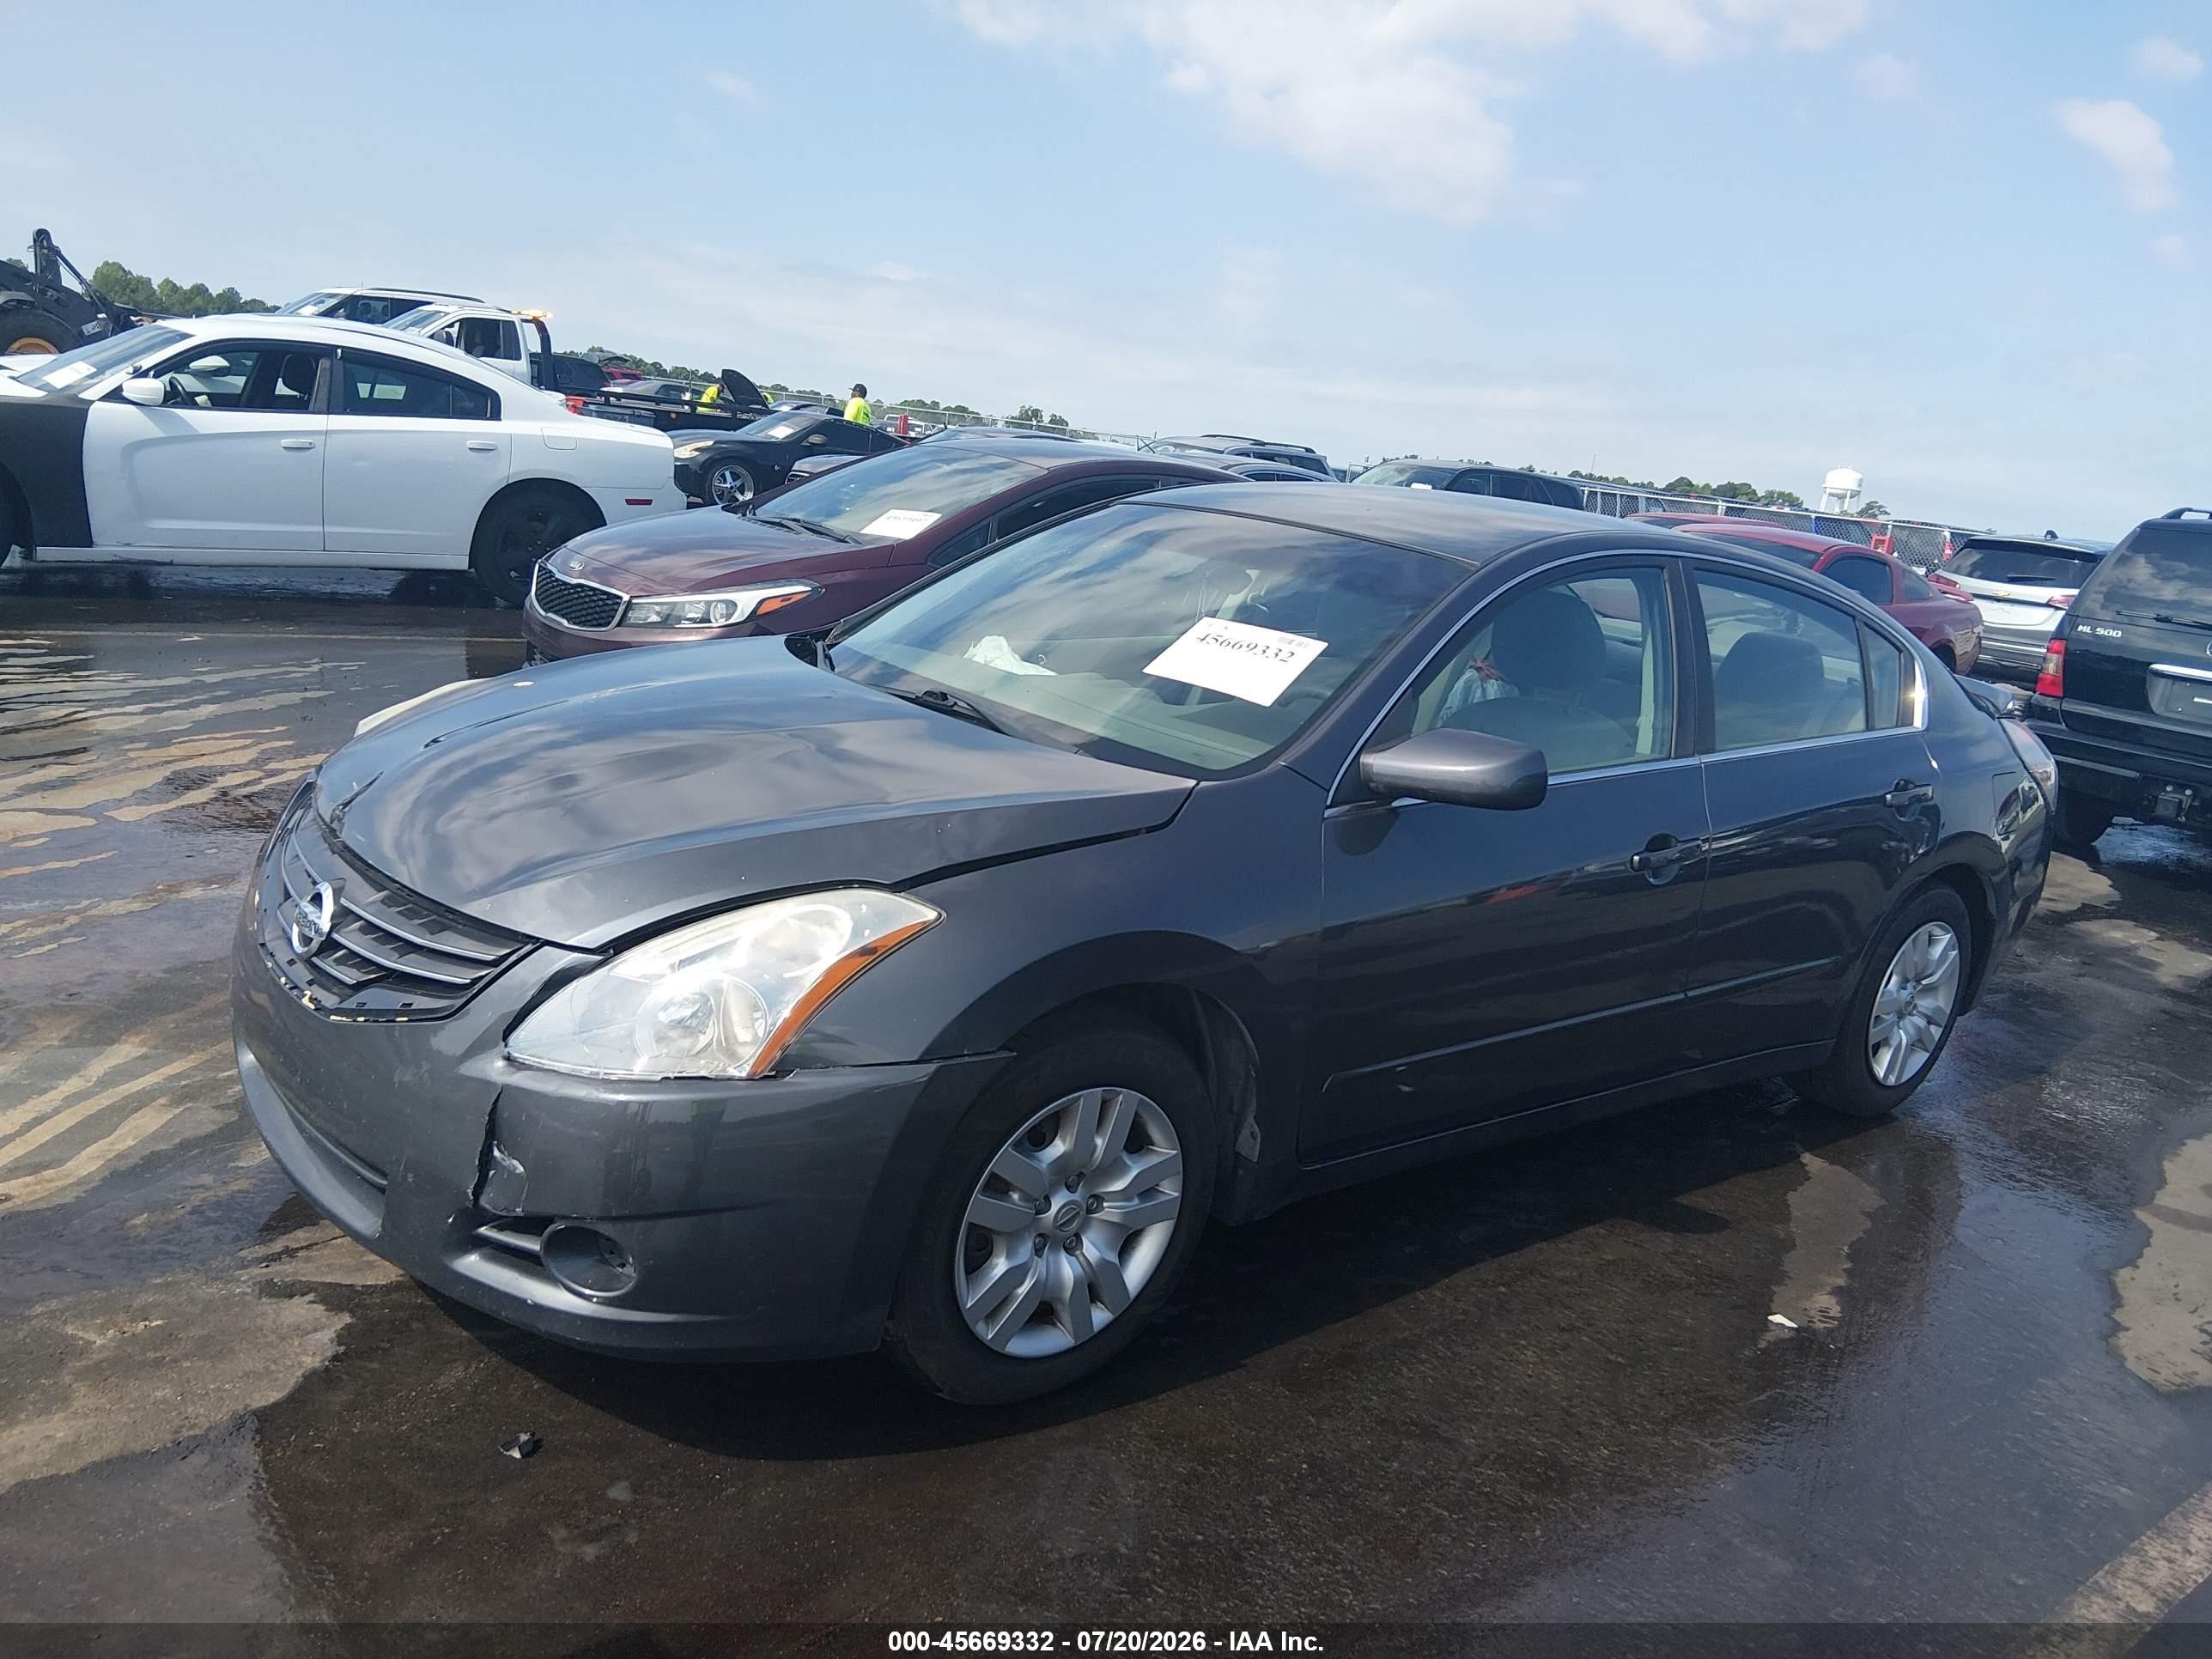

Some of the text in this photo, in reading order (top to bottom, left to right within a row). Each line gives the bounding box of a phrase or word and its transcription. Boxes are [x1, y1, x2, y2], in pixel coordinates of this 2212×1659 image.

[2076, 624, 2123, 639] ML 500
[1196, 632, 1296, 663] 45669332
